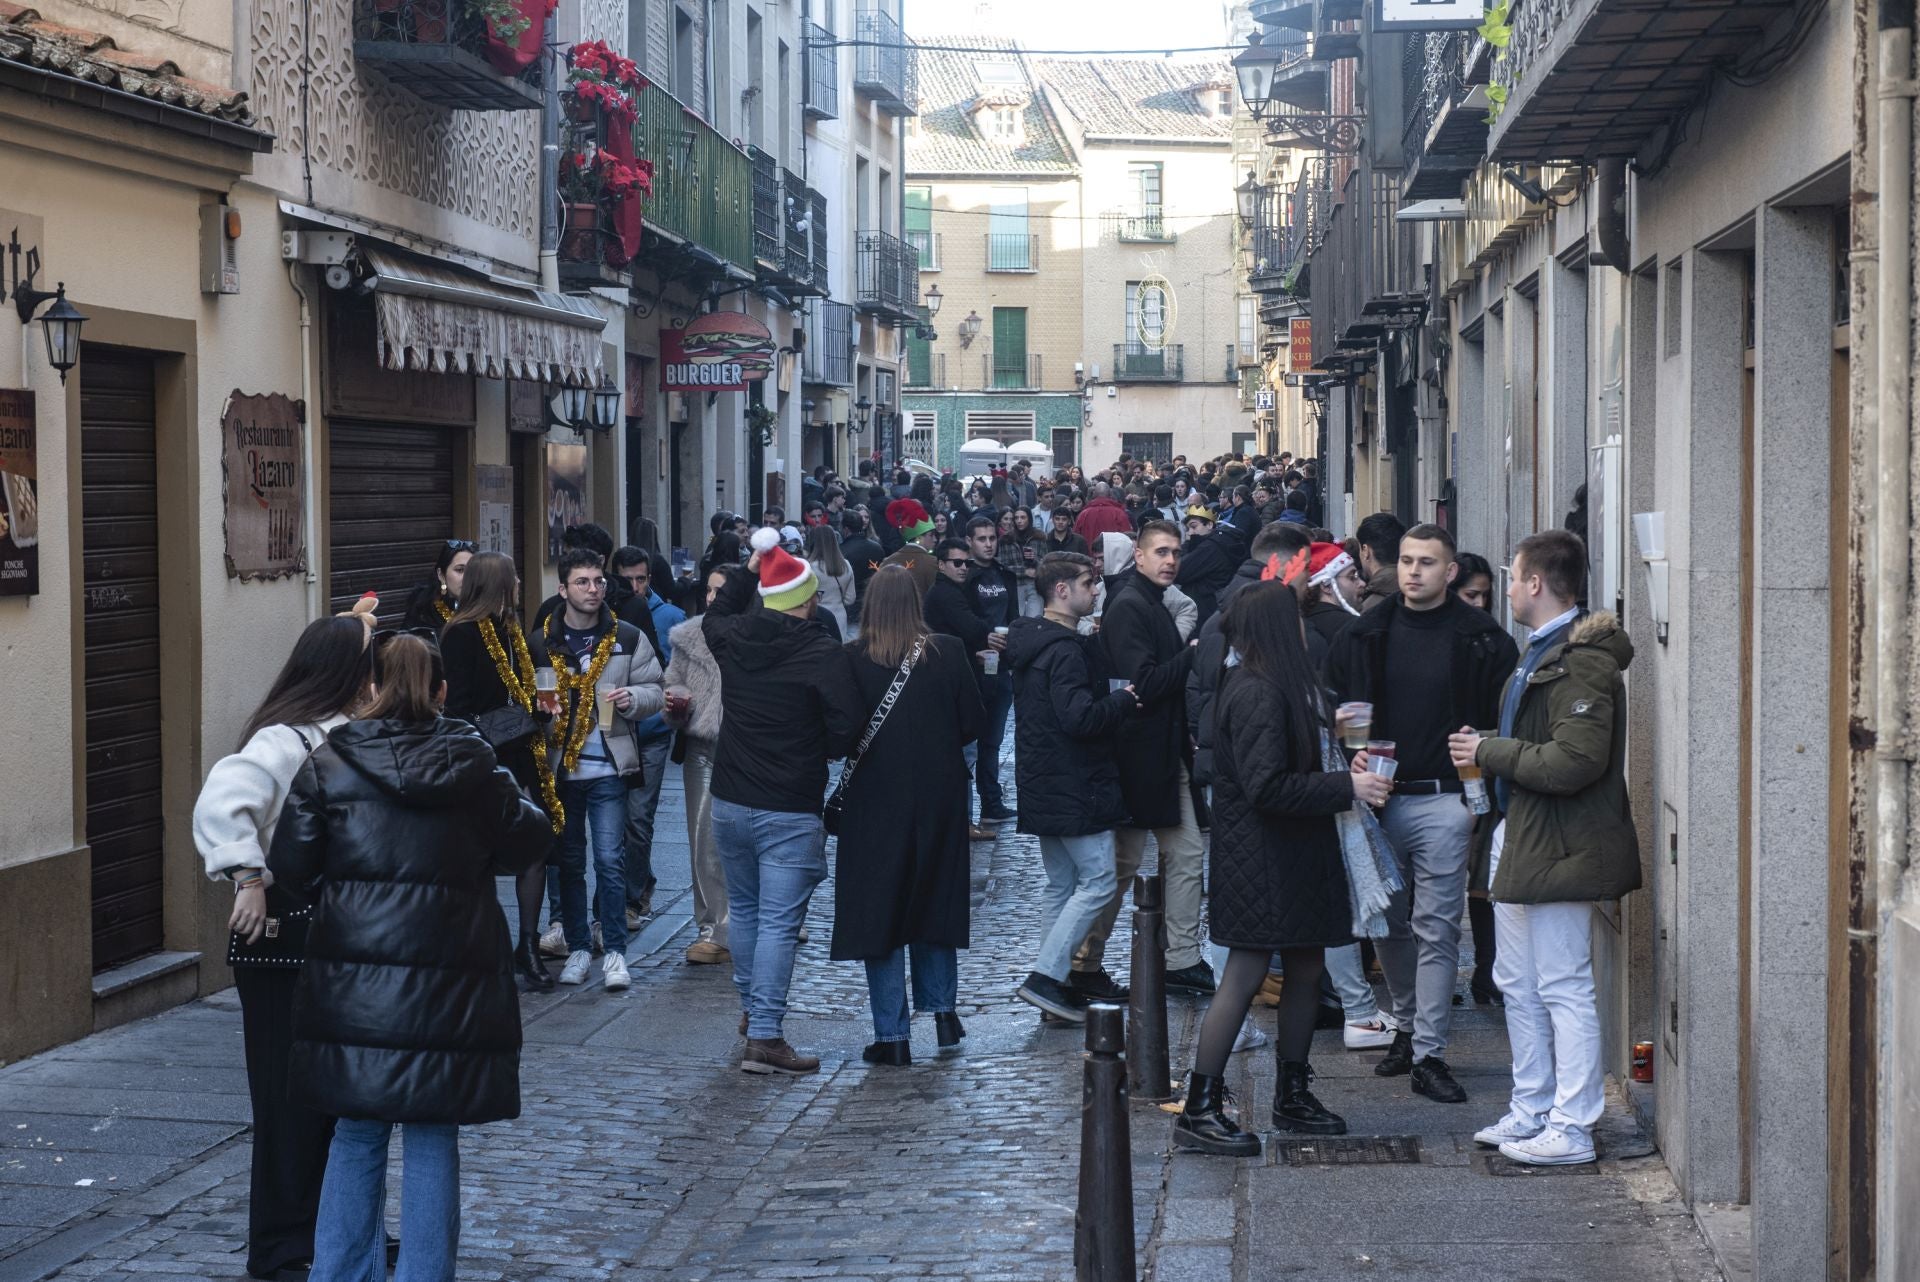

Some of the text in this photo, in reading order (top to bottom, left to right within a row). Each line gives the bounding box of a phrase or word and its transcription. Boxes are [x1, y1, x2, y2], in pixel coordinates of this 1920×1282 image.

[666, 363, 743, 386] BURGUER
[233, 417, 294, 450] Restaurante
[247, 450, 295, 497] Lázaro
[1, 568, 28, 579] SEGOVIANO
[4, 560, 24, 569] PONCHE
[881, 681, 903, 710] LOLA
